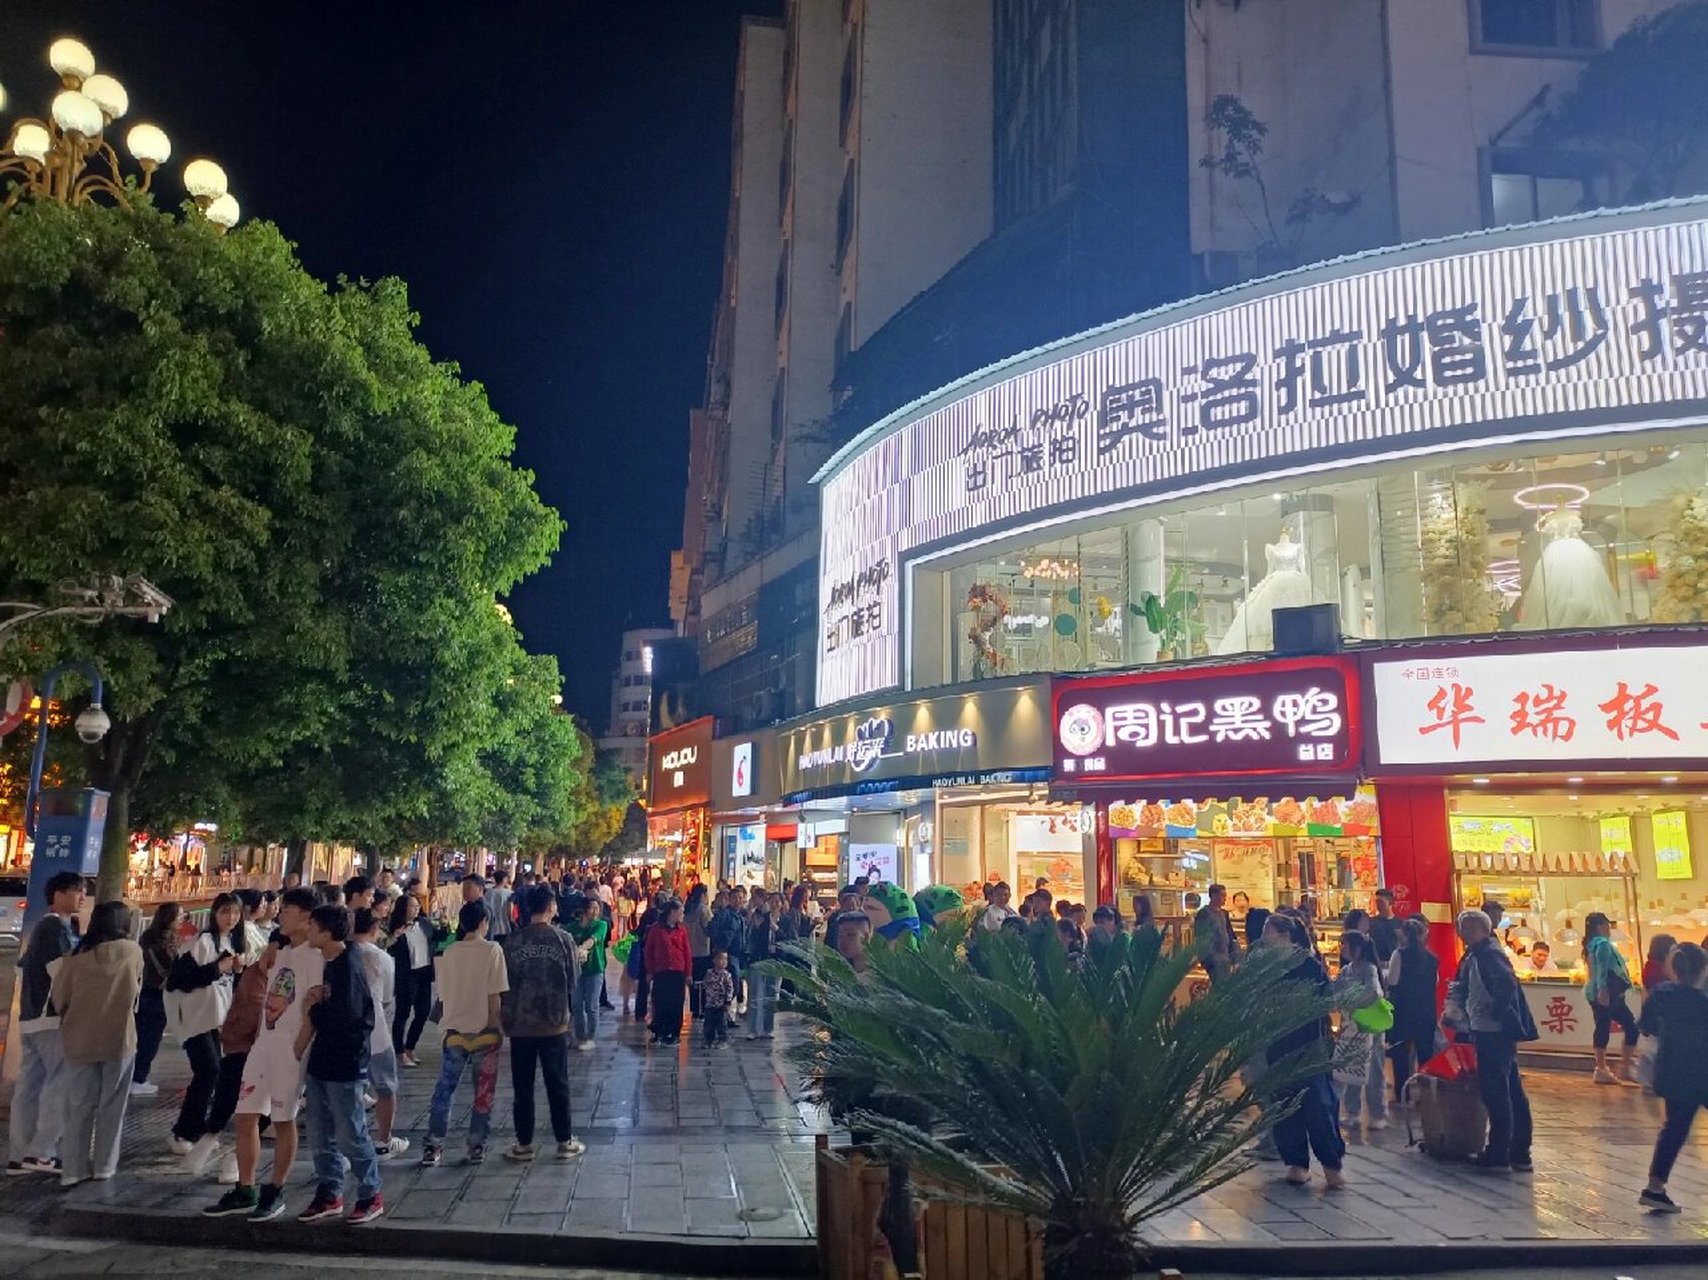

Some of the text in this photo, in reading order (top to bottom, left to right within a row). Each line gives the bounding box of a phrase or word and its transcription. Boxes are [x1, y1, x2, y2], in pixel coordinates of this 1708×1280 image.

[906, 728, 975, 753] BAKING
[1104, 686, 1342, 748] 周记黑鸭
[1418, 681, 1708, 750] 华瑞板
